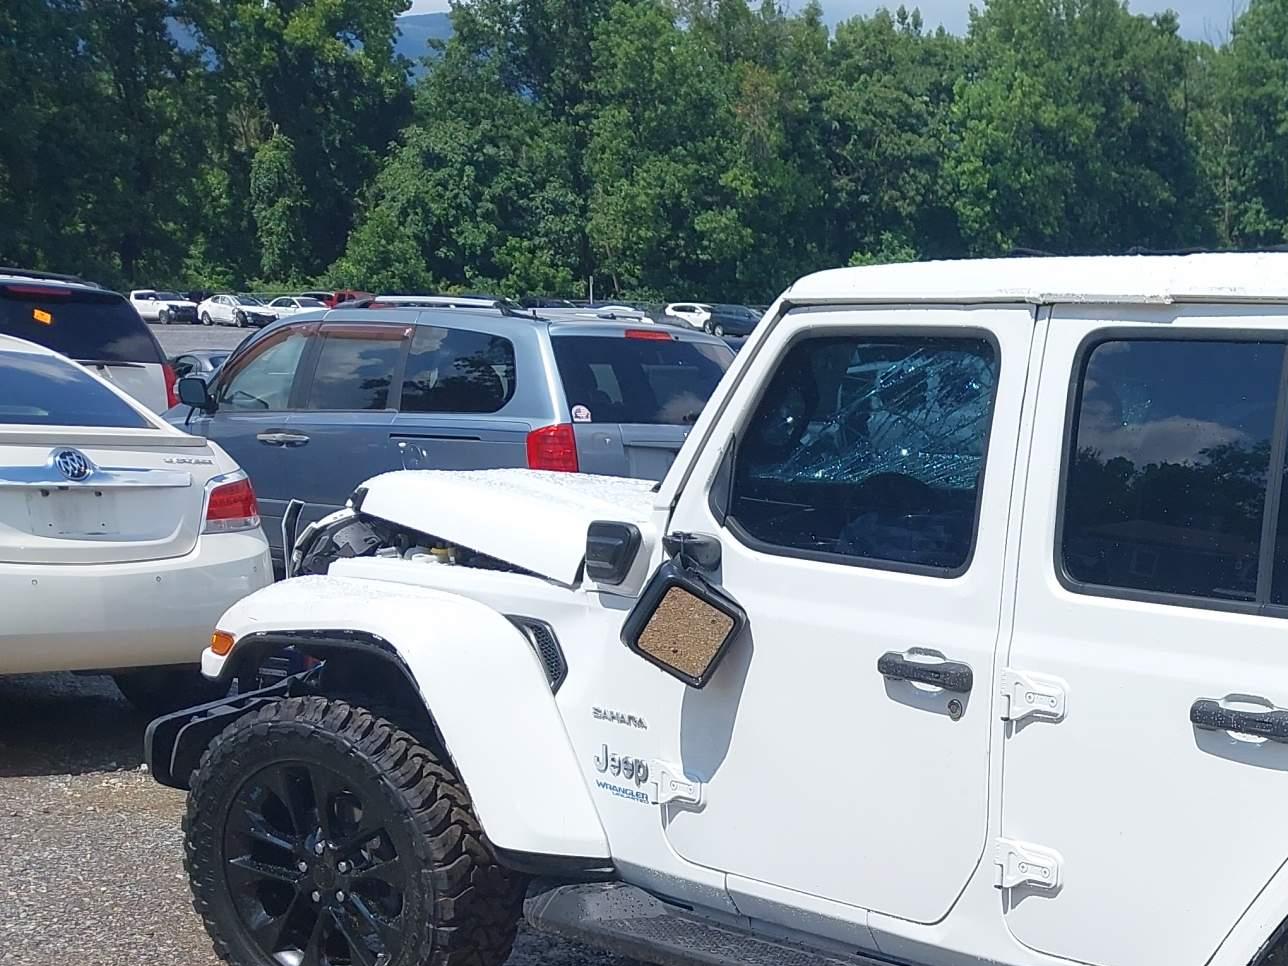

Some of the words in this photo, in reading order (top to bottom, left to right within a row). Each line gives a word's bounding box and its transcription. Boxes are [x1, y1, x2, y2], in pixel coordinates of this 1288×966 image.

[592, 706, 648, 730] SAHARA
[594, 743, 649, 787] Jeep
[595, 779, 649, 801] WRANGLER
